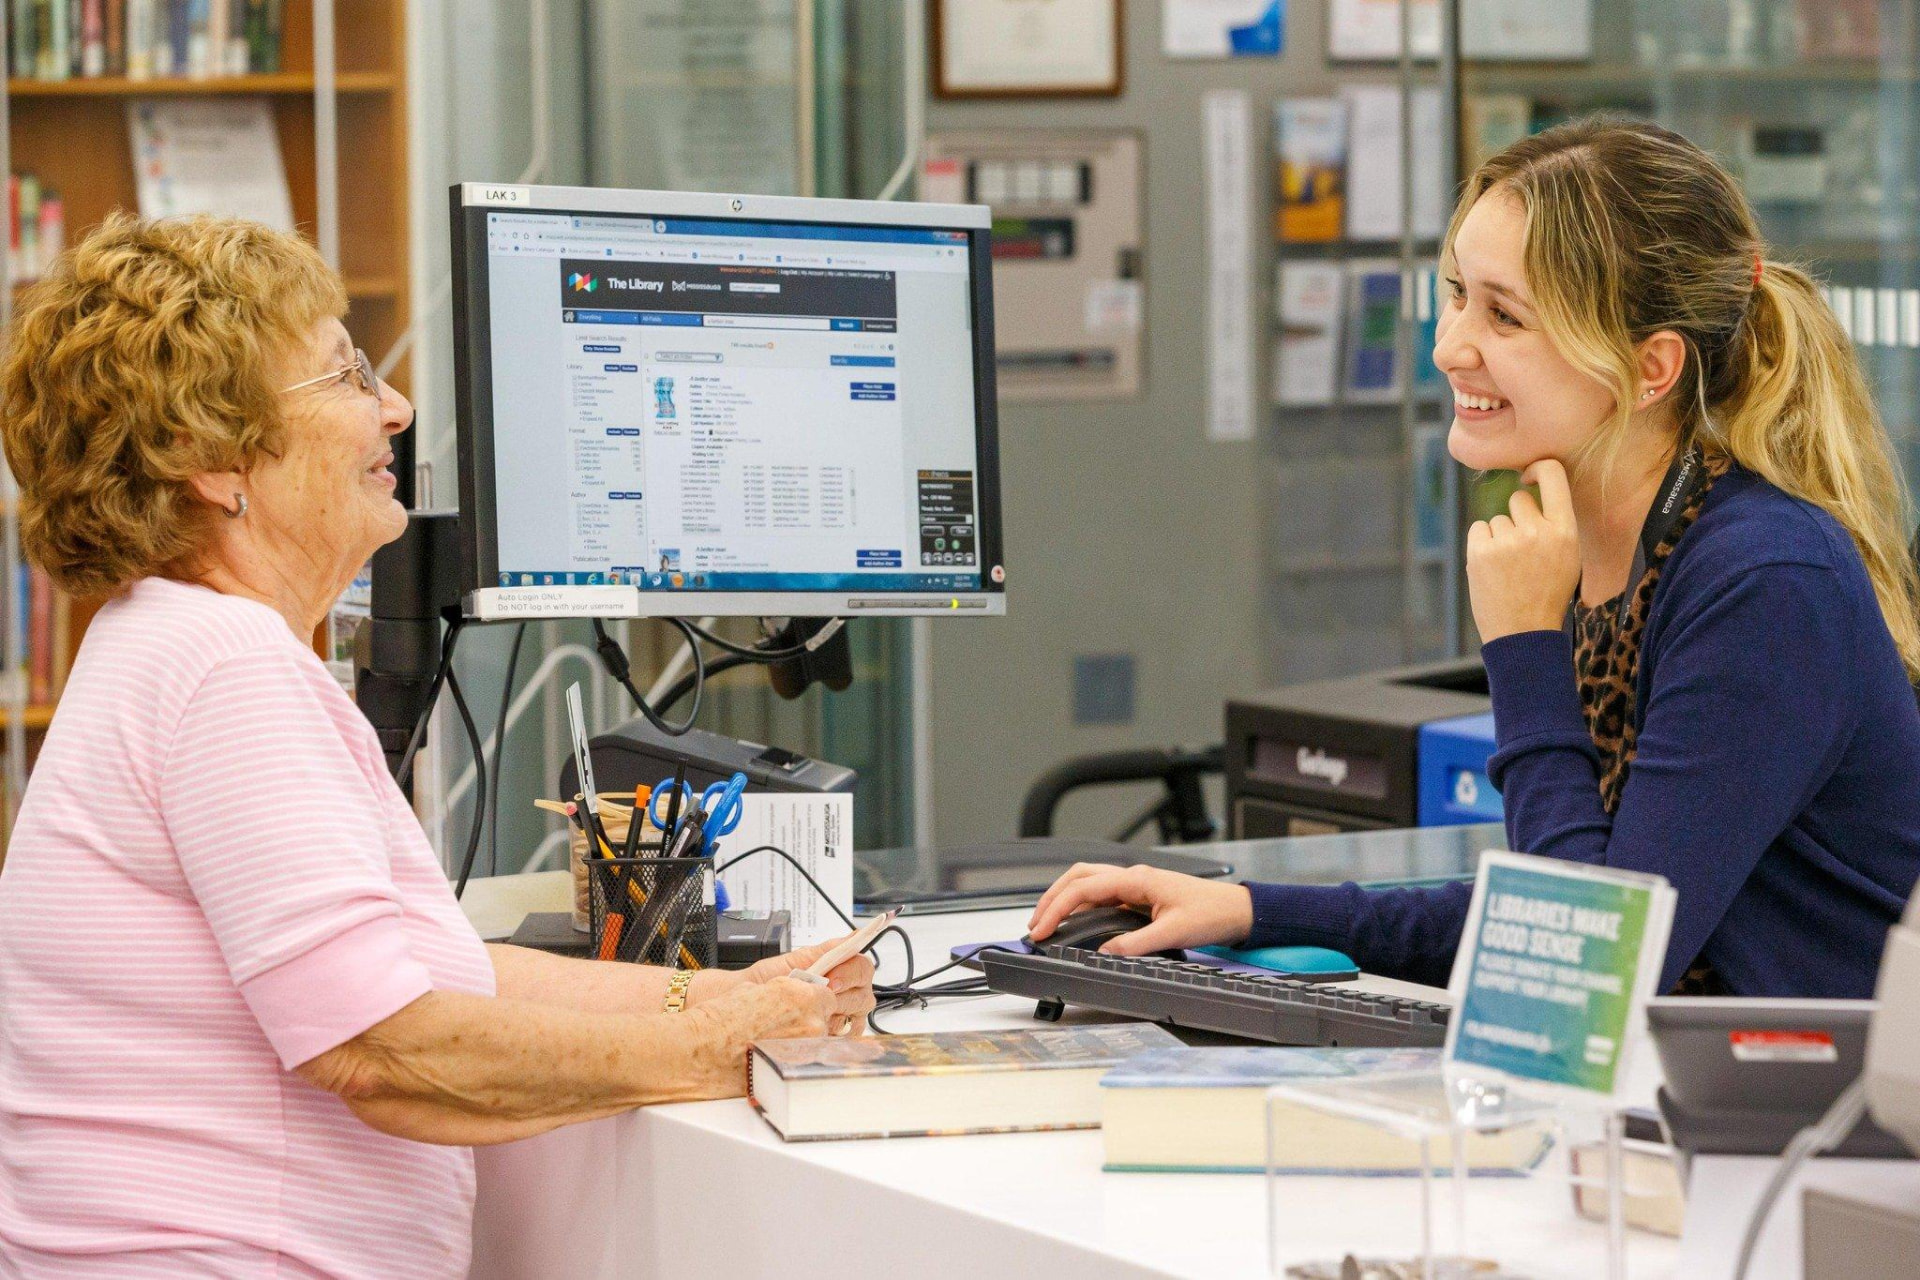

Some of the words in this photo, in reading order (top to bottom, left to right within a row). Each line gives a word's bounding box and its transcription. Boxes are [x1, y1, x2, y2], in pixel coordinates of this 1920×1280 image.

[486, 190, 507, 200] LAK
[511, 192, 517, 201] 3
[608, 278, 627, 289] The
[628, 278, 664, 293] Library
[518, 594, 539, 602] Login
[530, 604, 542, 612] log
[1488, 893, 1571, 931] LIBRARIES
[1572, 906, 1622, 942] MAKE
[1482, 919, 1528, 952] GOOD
[1528, 928, 1586, 964] SENSE
